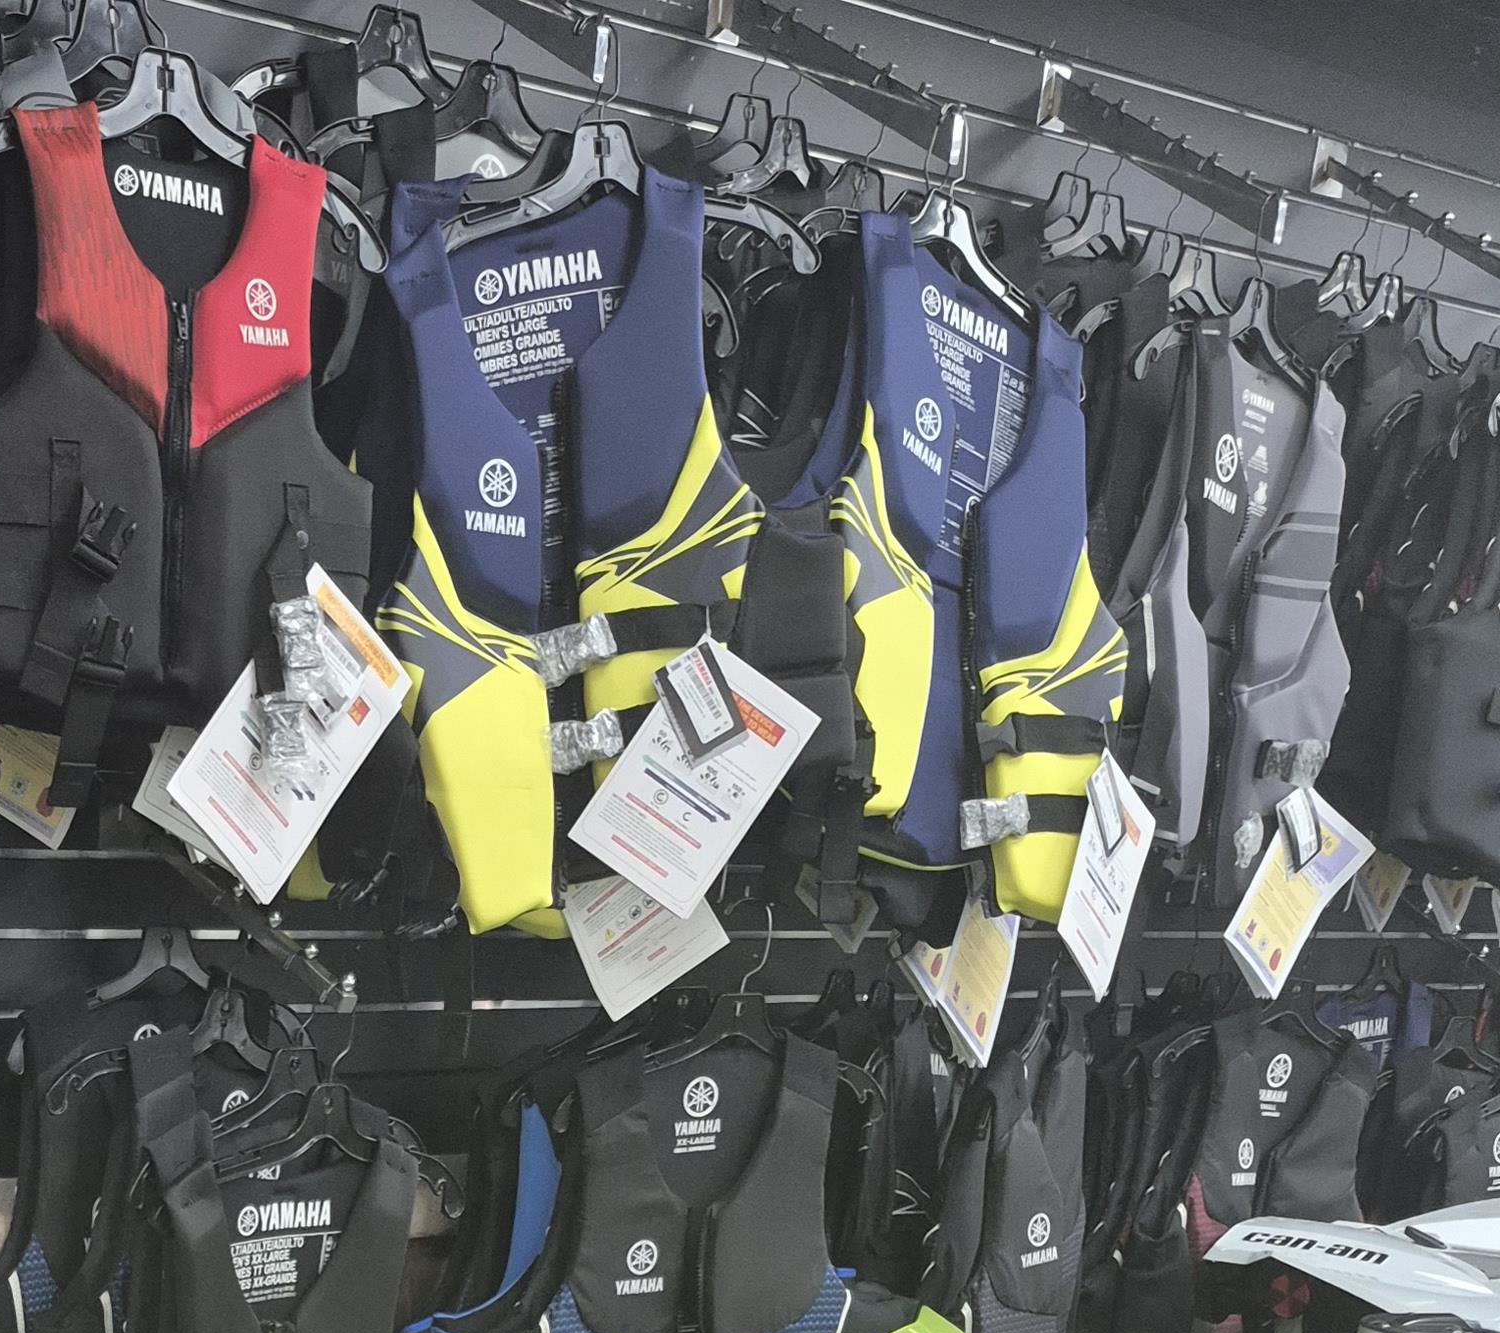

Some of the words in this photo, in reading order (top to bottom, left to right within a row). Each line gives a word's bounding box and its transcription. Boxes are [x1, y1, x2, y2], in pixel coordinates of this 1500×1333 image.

[138, 170, 224, 216] YAMAHA
[502, 249, 603, 297] YAMAHA
[464, 297, 573, 334] ULT/ADULTE/ADULTO
[942, 295, 1009, 356] YAMAHA
[239, 324, 290, 348] YAMAHA
[476, 325, 510, 345] MEN'S
[511, 316, 549, 337] LARGE
[473, 340, 514, 361] OMMES
[515, 329, 562, 351] GRANDE
[939, 341, 965, 366] LARGE
[480, 354, 519, 375] MBRES
[520, 344, 566, 365] GRANDE
[940, 356, 972, 382] GRANDE
[941, 371, 973, 396] GRANDE
[902, 427, 943, 476] YAMAHA
[1203, 477, 1238, 515] YAMAHA
[464, 510, 526, 538] YAMAHA
[674, 1118, 721, 1136] YAMAHA
[259, 1200, 332, 1232] YAMAHA
[232, 1255, 250, 1268] EN'S
[251, 1250, 291, 1265] XX-LARGE
[1020, 1246, 1059, 1269] YAMAHA
[1242, 1230, 1390, 1266] can-am
[252, 1271, 298, 1289] XX-GRANDE
[264, 1259, 298, 1275] GRANDE
[615, 1277, 664, 1296] YAMAHA
